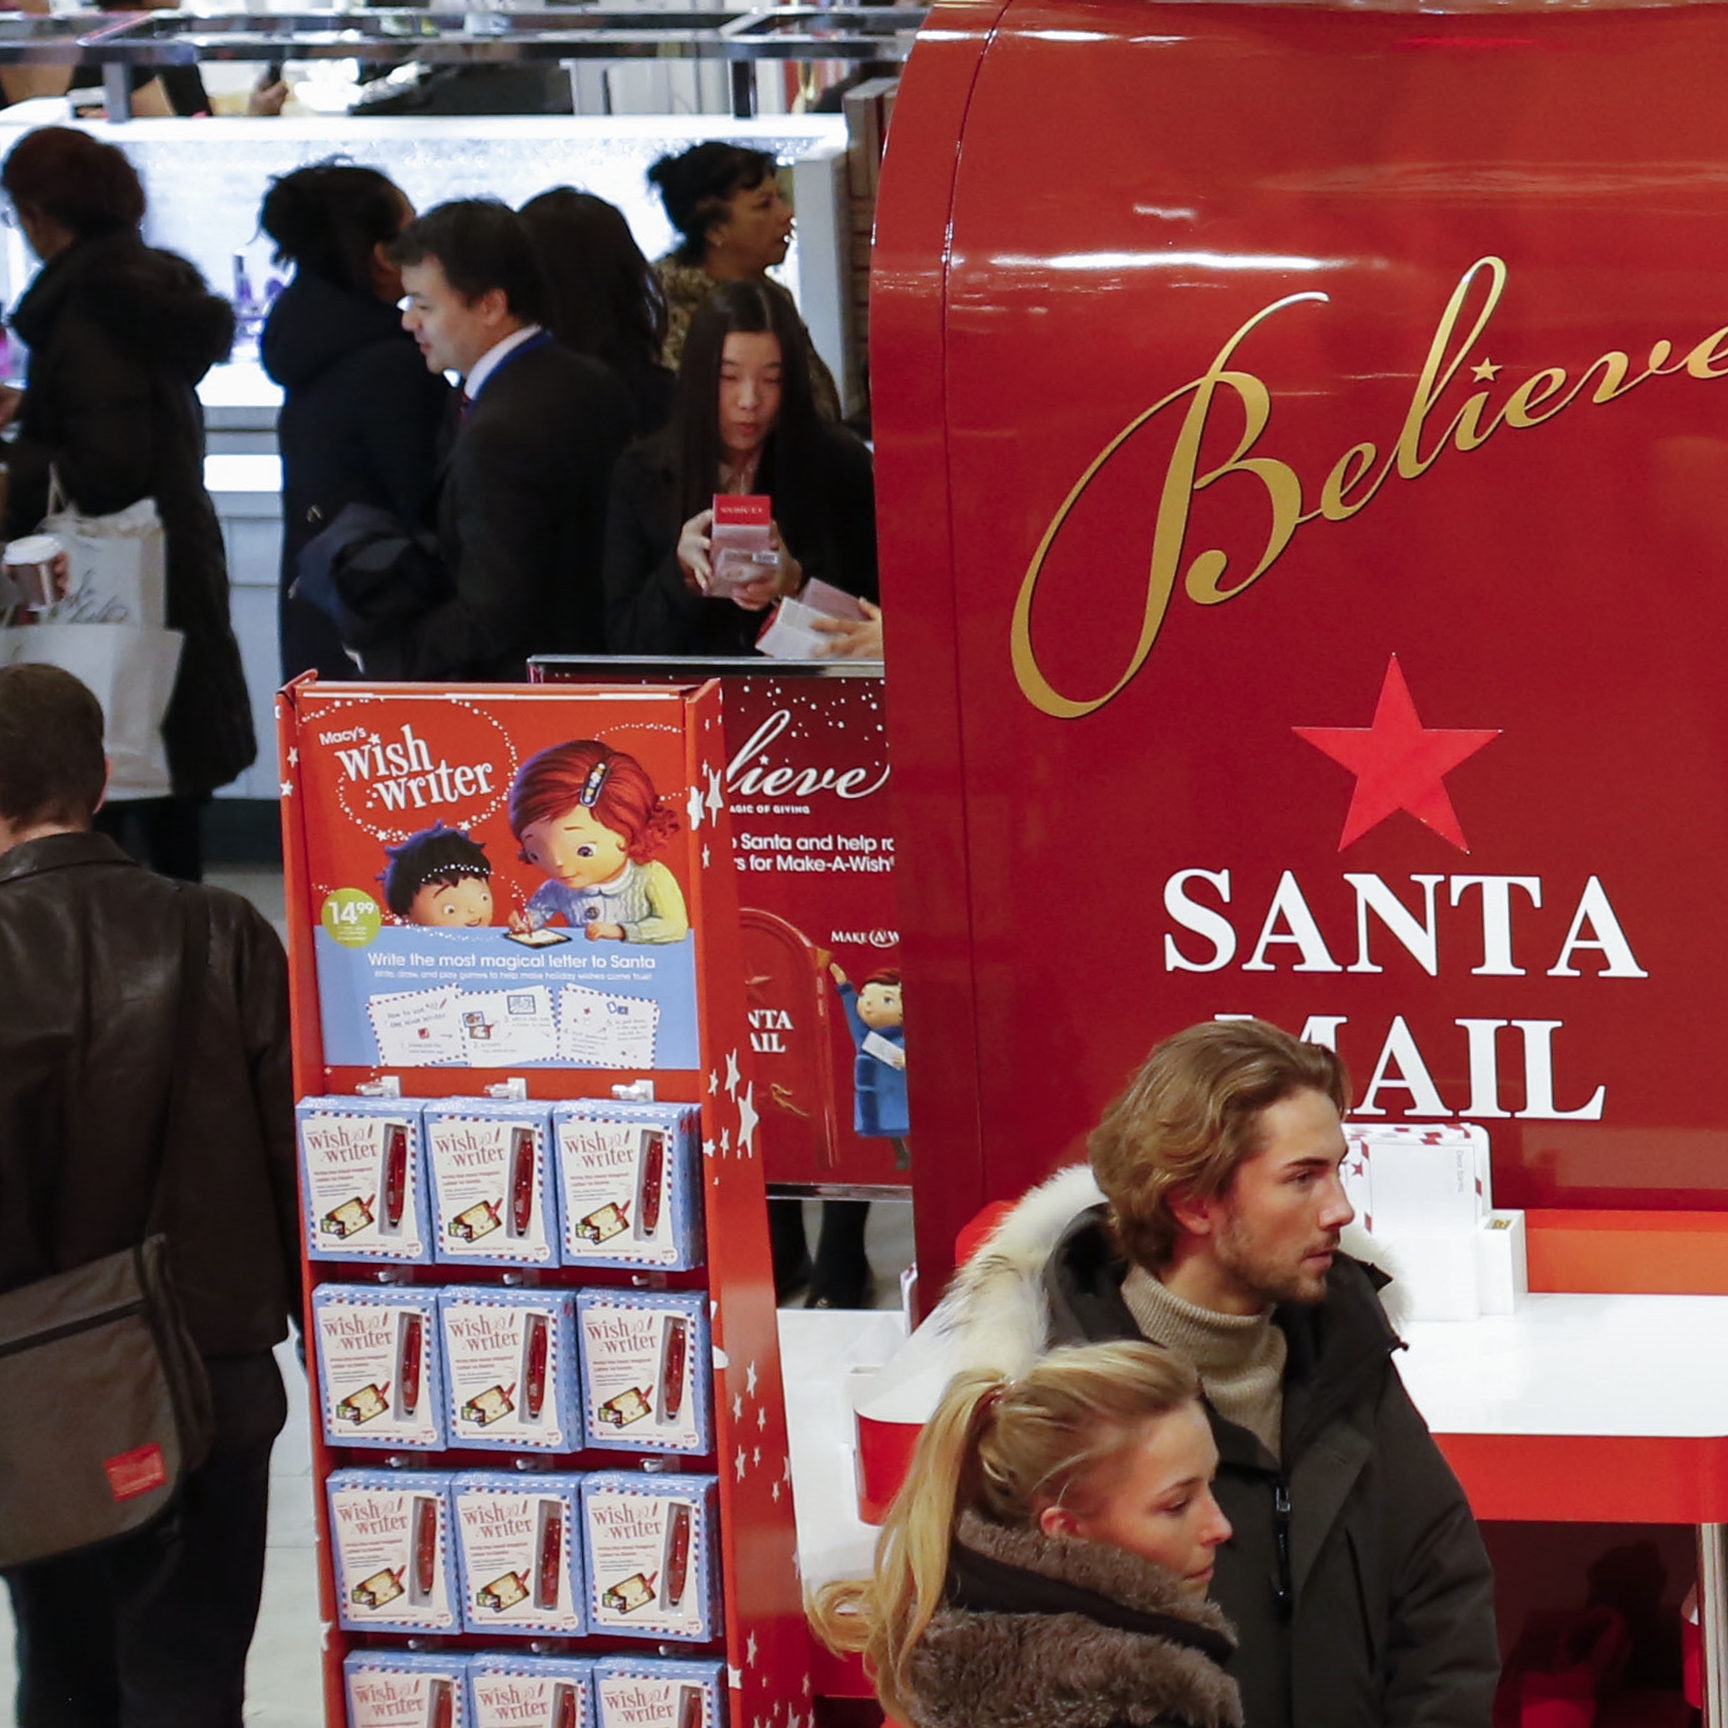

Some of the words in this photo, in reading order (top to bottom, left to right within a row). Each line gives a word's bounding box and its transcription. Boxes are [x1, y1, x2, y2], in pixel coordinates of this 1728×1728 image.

[319, 726, 367, 746] Macy's
[373, 759, 493, 812] writer
[756, 804, 770, 814] OF
[773, 804, 811, 814] GIVING
[740, 833, 792, 850] Santa
[796, 834, 833, 850] and
[837, 834, 877, 853] help
[750, 854, 772, 871] for
[1164, 869, 1648, 978] SANTA
[367, 952, 405, 966] Write
[410, 954, 434, 966] the
[439, 954, 476, 967] most
[480, 954, 545, 971] magical
[549, 955, 587, 968] letter
[591, 956, 607, 969] to
[610, 955, 656, 969] Santa
